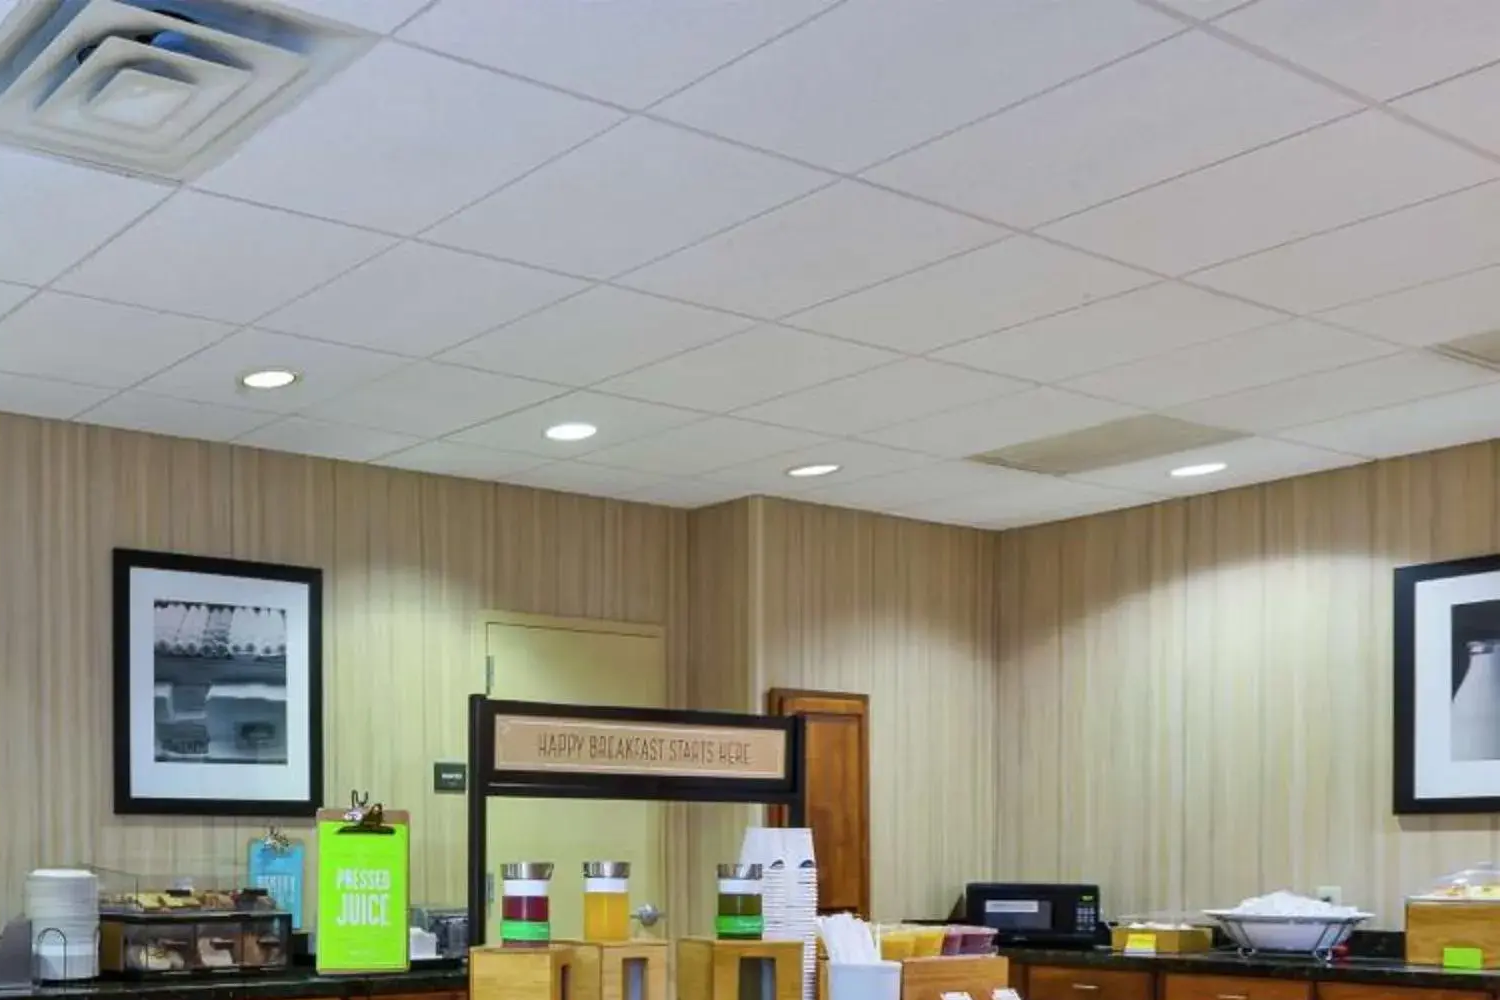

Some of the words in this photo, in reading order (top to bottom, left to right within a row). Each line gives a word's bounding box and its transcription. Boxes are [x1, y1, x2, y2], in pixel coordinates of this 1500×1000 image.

[538, 732, 585, 757] HAPPY
[589, 735, 665, 762] BREAKFAST
[669, 739, 715, 765] STARTS
[718, 742, 752, 766] HERE
[335, 868, 390, 891] PRESSED
[336, 893, 390, 927] JUICE
